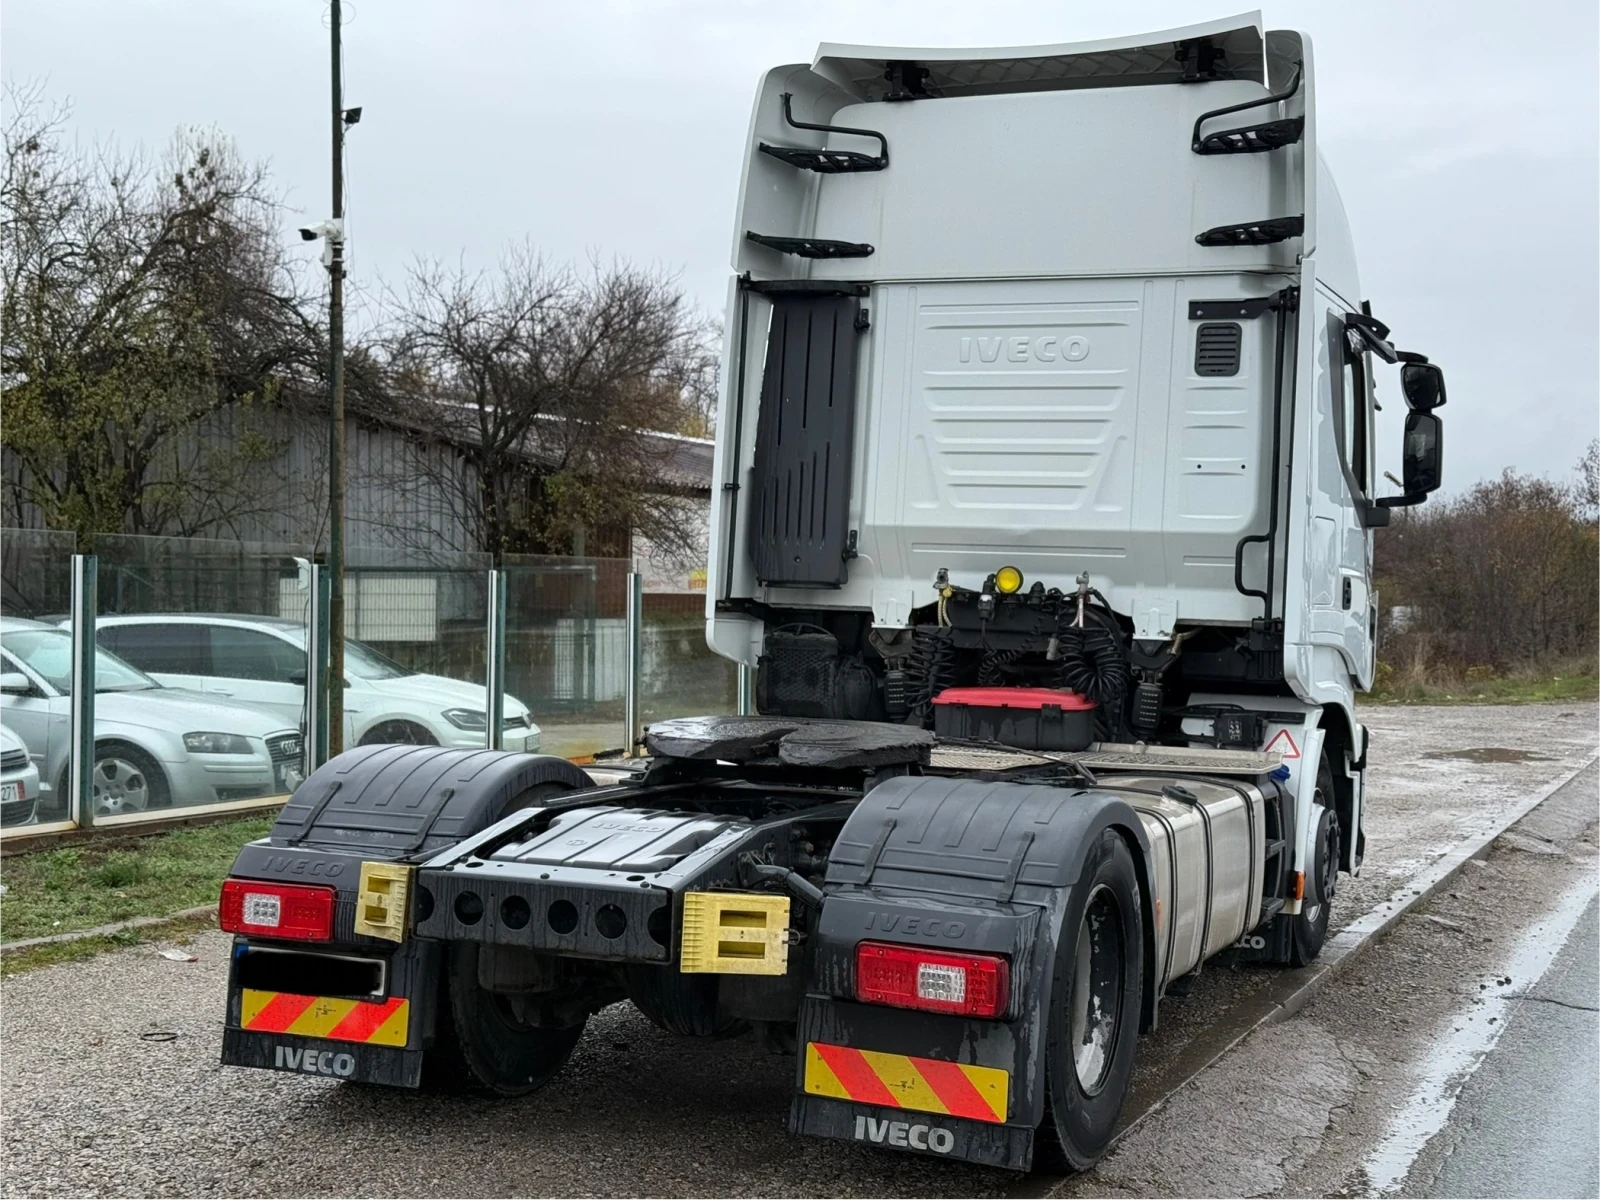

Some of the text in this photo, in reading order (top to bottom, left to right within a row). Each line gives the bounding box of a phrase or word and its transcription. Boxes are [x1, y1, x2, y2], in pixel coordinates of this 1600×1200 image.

[959, 335, 1090, 364] IVECO
[592, 822, 665, 833] IVECO
[261, 855, 346, 878] IVECO
[864, 911, 967, 940] IVECO
[275, 1045, 355, 1076] IVECO
[854, 1115, 955, 1154] IVECO
